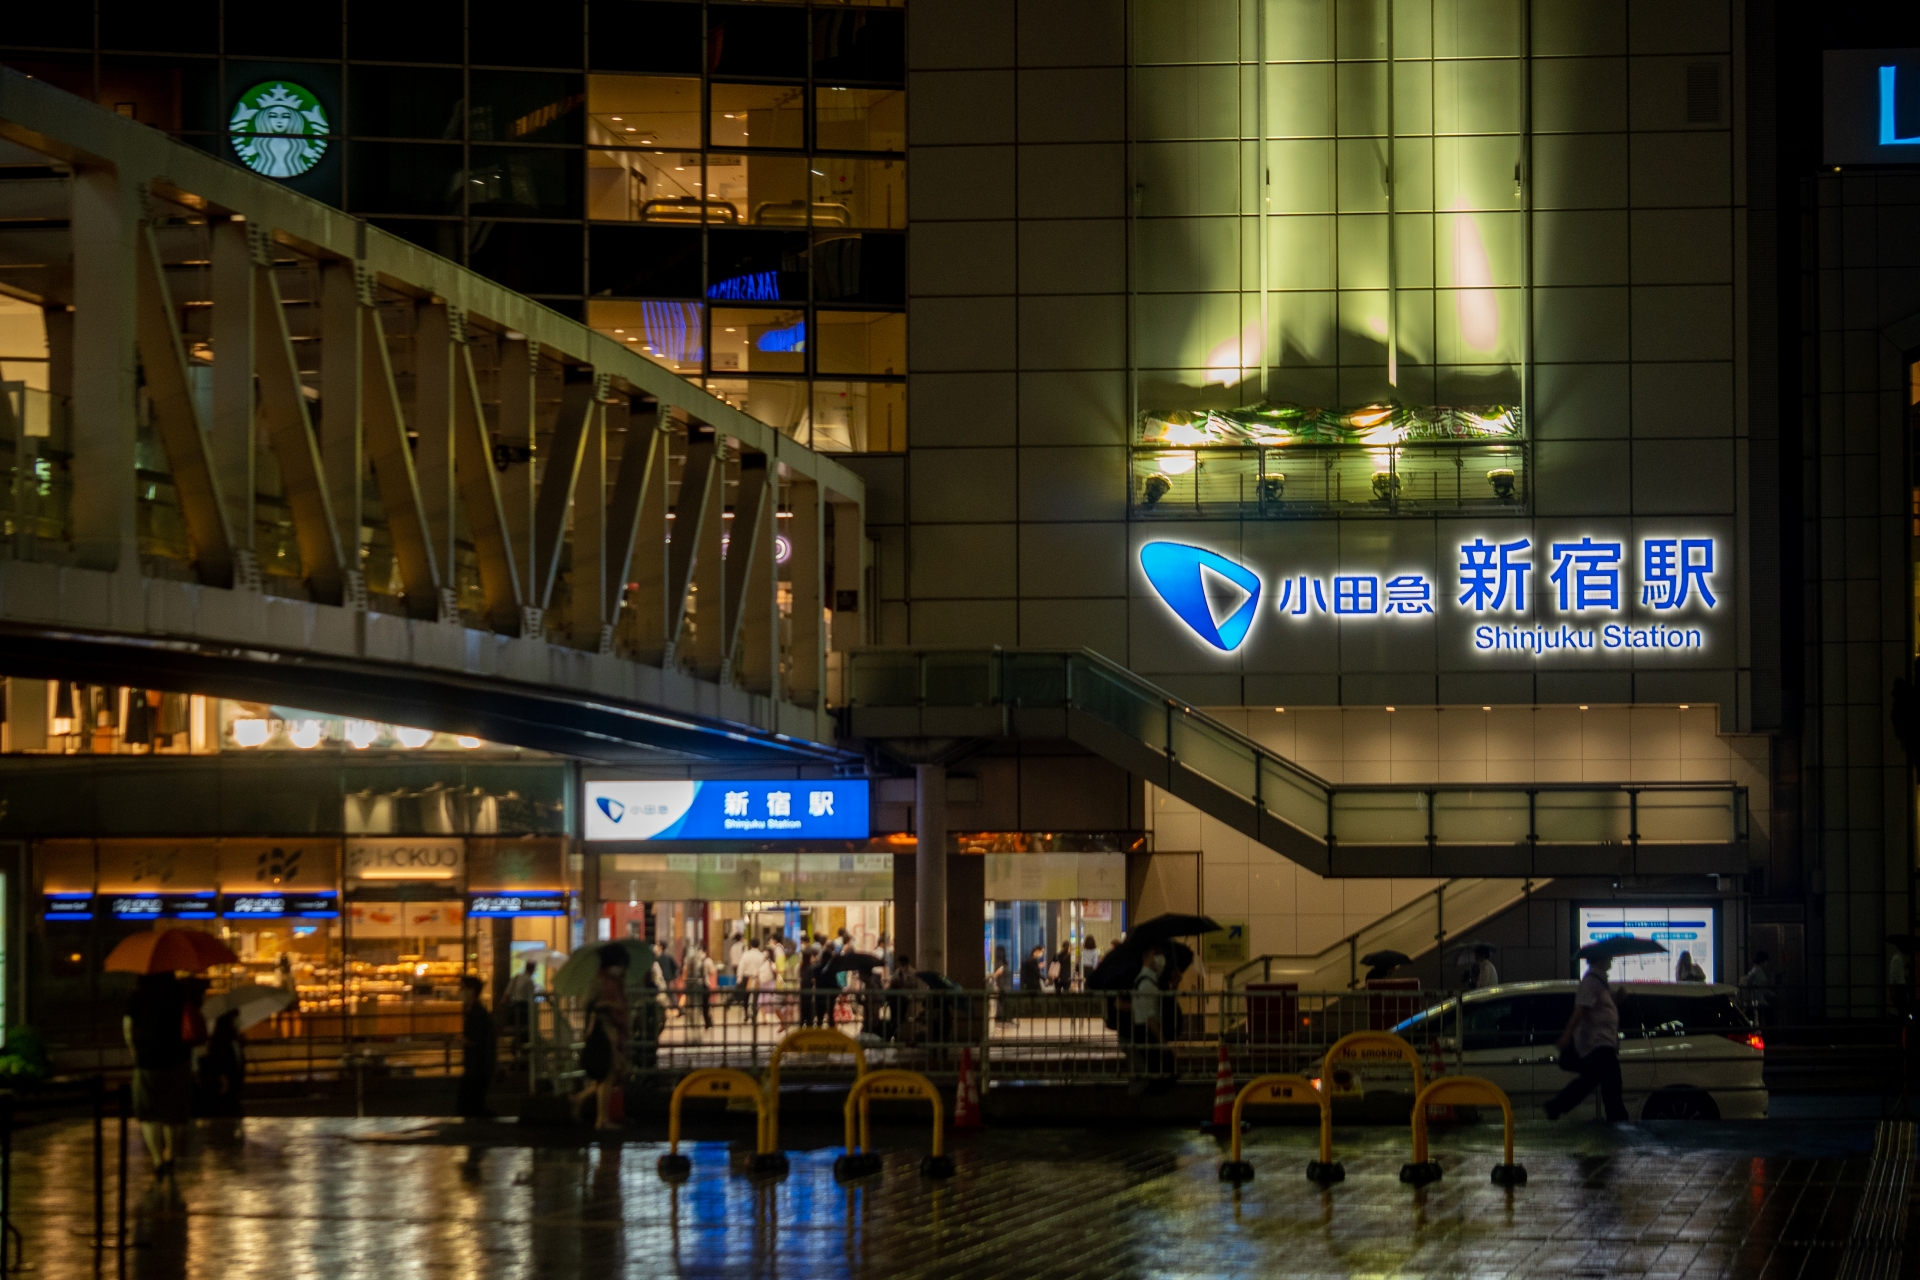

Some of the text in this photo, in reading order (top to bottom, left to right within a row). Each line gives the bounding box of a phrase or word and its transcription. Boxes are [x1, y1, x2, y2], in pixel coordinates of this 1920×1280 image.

[1280, 537, 1716, 615] 小田急 新宿駅
[1475, 625, 1702, 654] Shinjuku Station
[724, 790, 834, 817] 新宿駅
[724, 818, 802, 831] Shinjuku Station
[377, 847, 459, 867] HOKUO
[1342, 1047, 1403, 1059] No smoking
